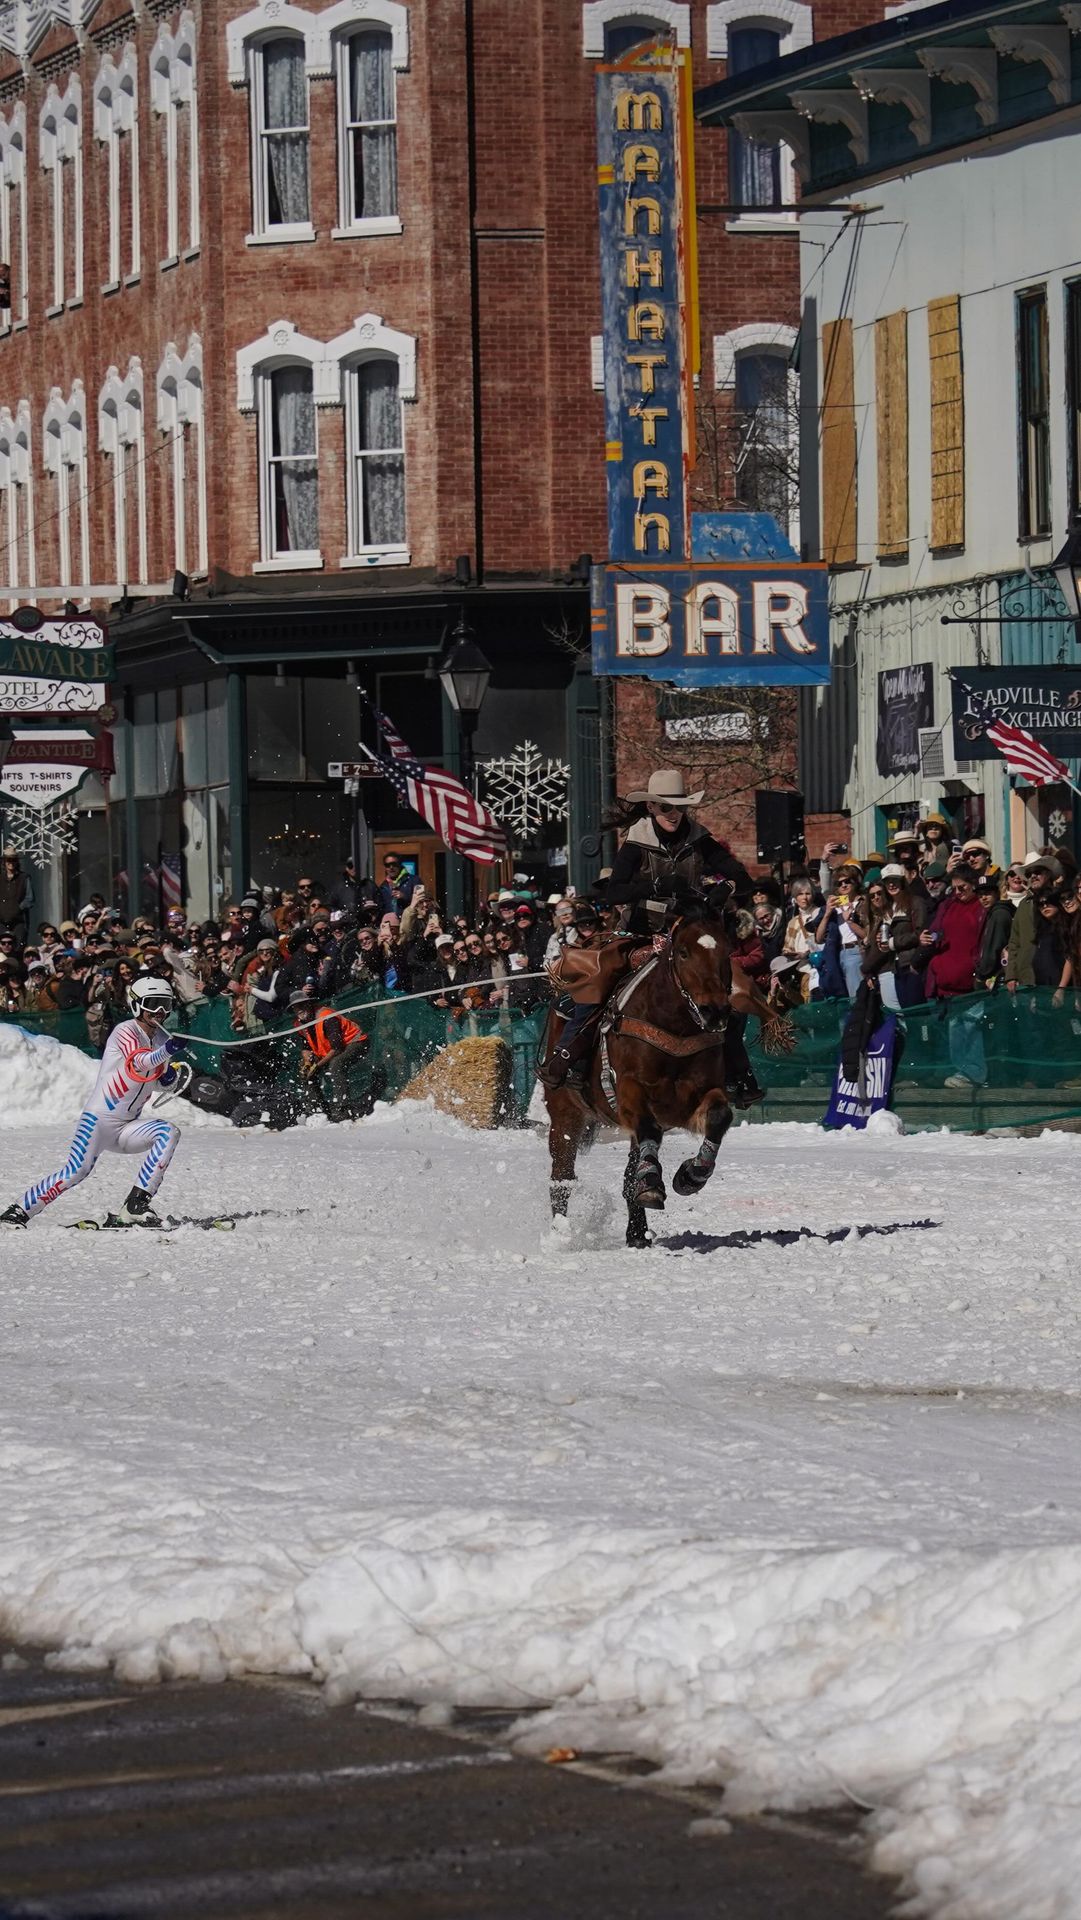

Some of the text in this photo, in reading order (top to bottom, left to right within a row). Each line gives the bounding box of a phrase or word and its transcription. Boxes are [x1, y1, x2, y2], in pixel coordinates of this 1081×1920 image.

[615, 581, 817, 657] BAR
[353, 764, 369, 776] 7th
[30, 772, 73, 781] T-SHIRTS
[10, 784, 62, 792] SOUVENIRS
